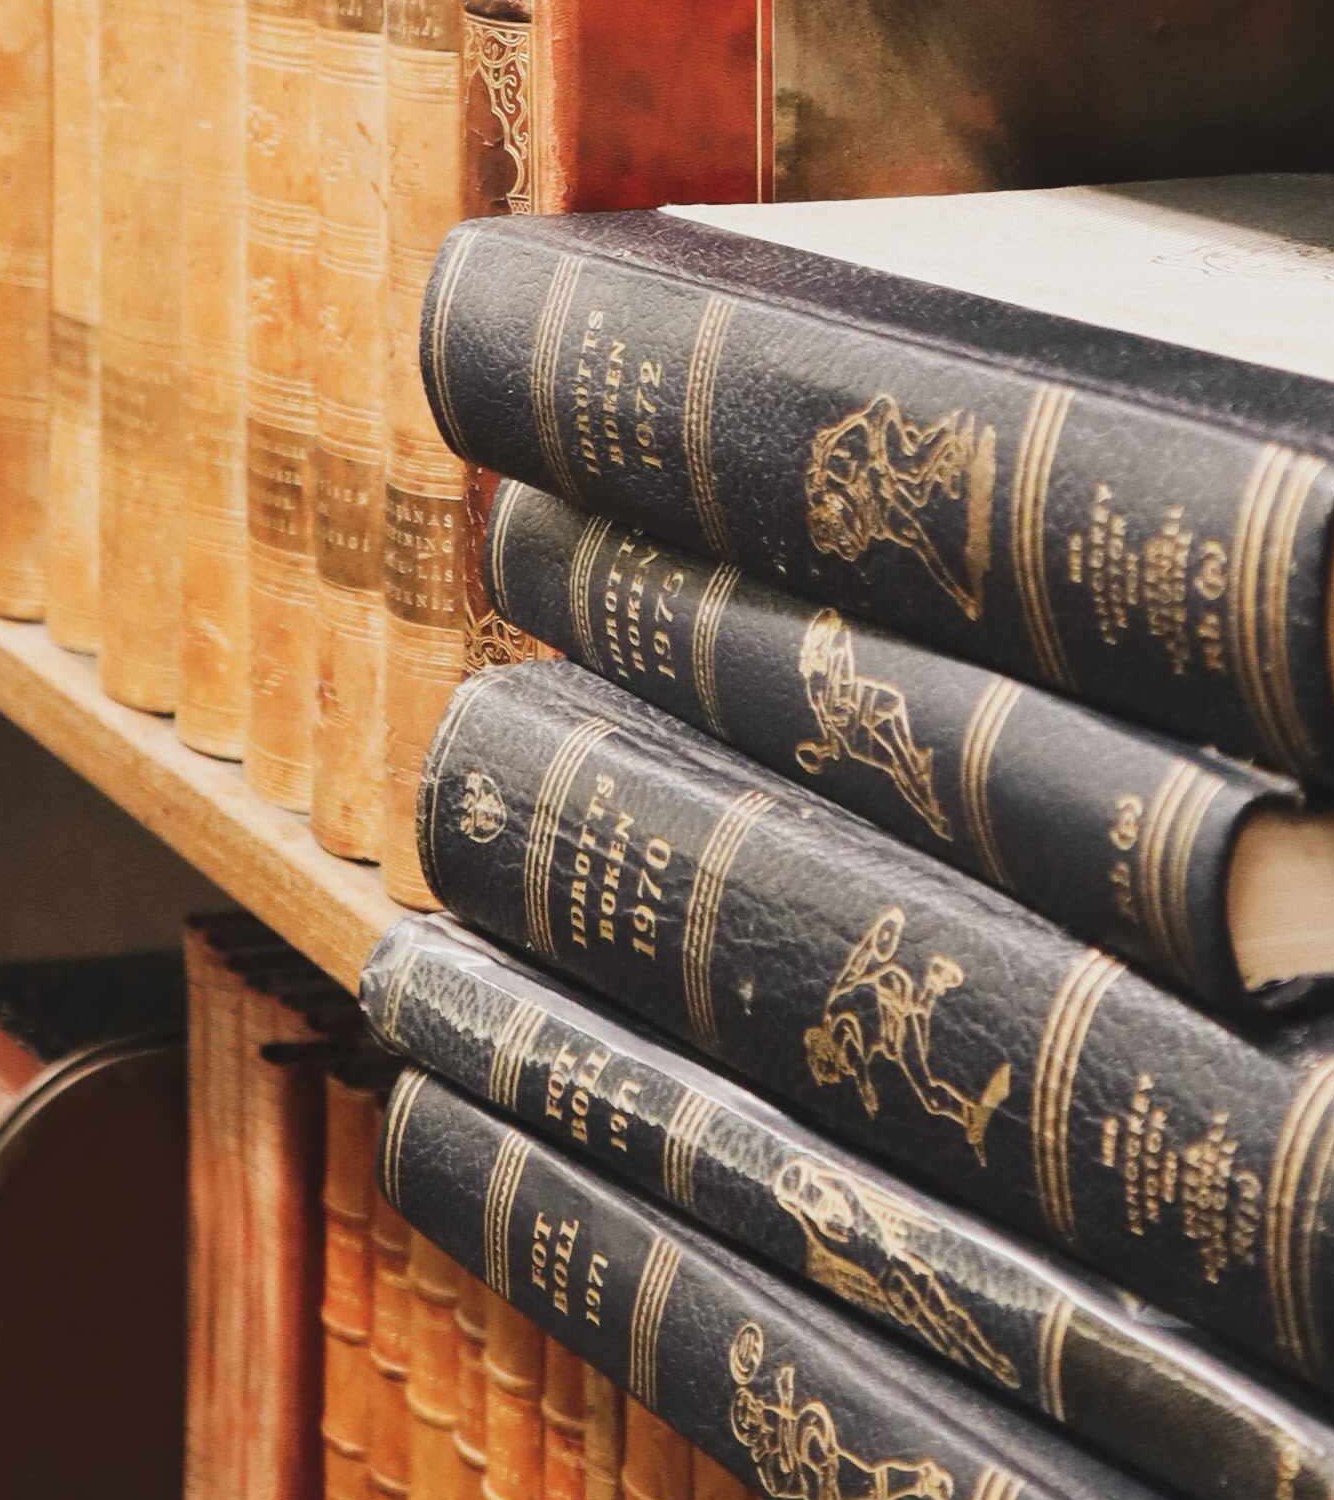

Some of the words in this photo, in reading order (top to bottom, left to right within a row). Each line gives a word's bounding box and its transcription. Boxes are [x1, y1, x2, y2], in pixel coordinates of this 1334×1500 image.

[579, 307, 605, 476] IDROTTS
[602, 338, 627, 468] BOKEN
[638, 357, 663, 471] 1972
[627, 549, 658, 673] BOKEN
[653, 568, 685, 682] 1975
[571, 771, 616, 950] IDROTTS
[597, 808, 635, 944] BOKEN
[633, 835, 674, 962] 1970
[545, 1040, 578, 1121] FOT
[570, 1050, 612, 1146] BOLL
[531, 1210, 553, 1291] FOT
[553, 1218, 579, 1317] BOLL
[585, 1250, 610, 1328] 1971
